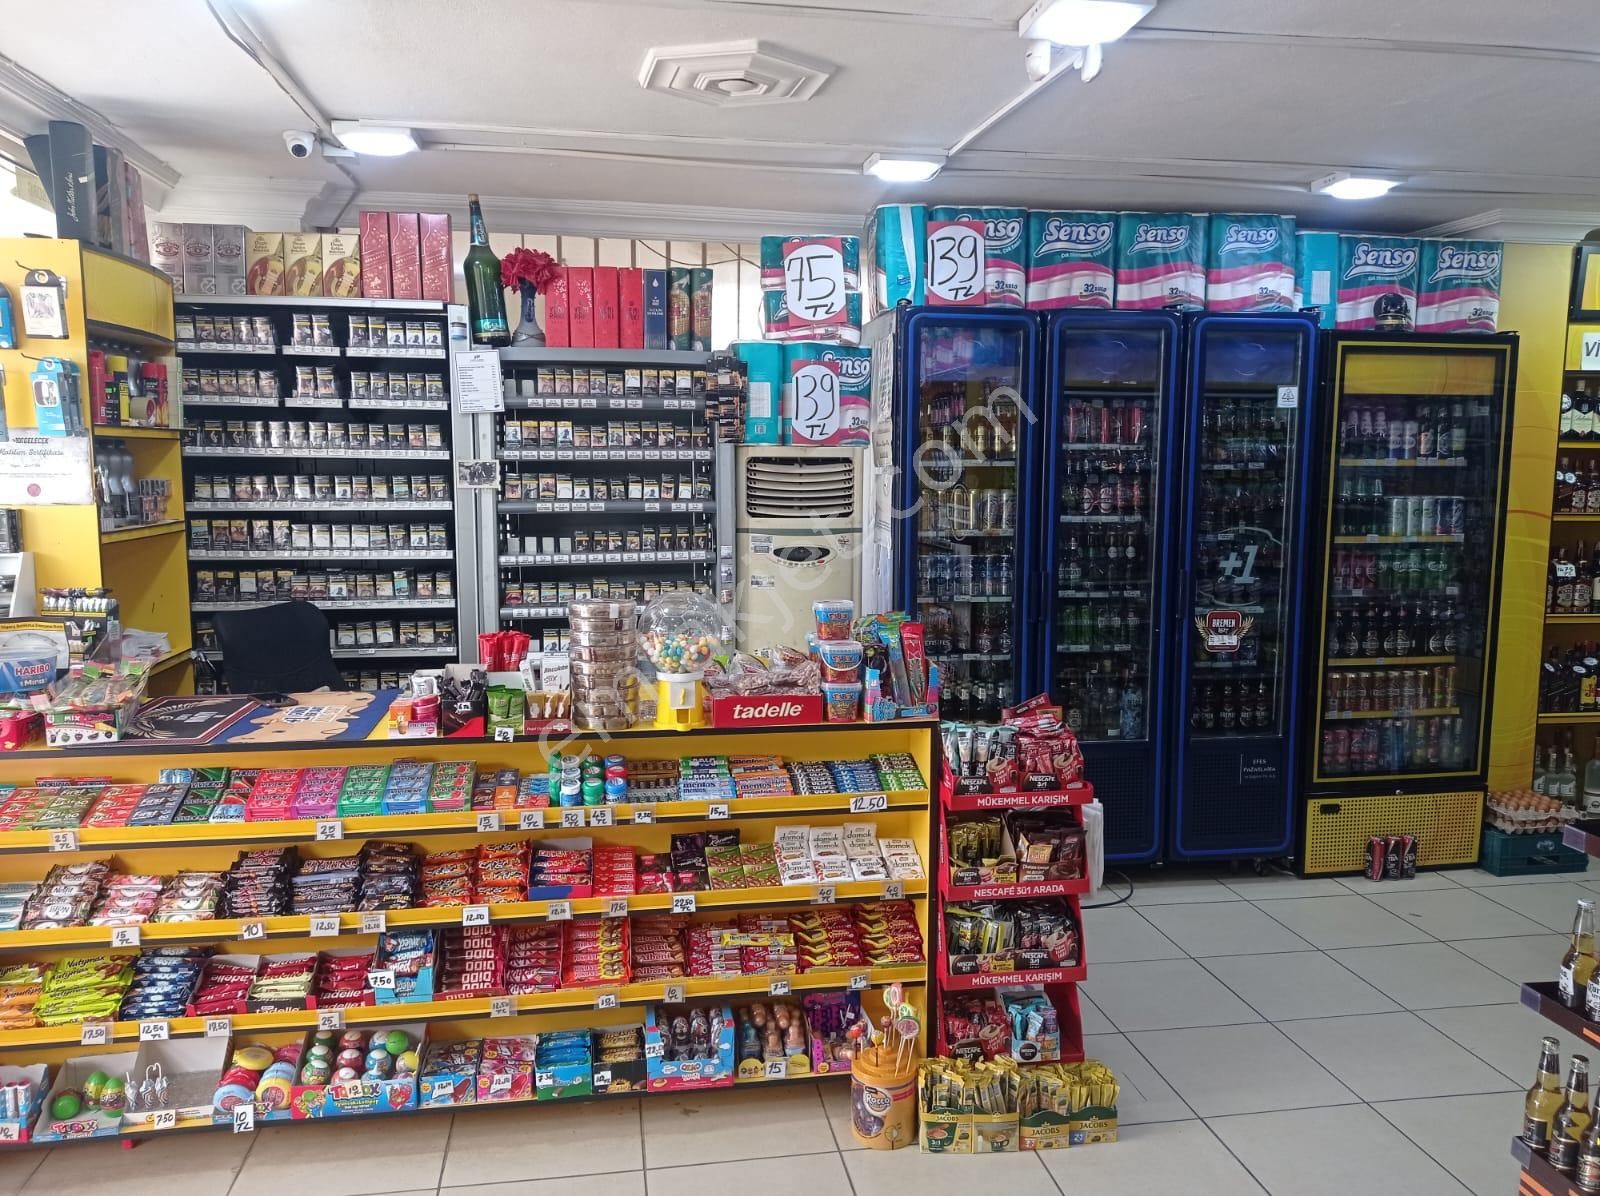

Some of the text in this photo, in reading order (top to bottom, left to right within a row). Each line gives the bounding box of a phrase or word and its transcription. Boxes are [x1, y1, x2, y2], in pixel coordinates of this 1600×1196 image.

[1046, 217, 1113, 243] Senso
[1134, 223, 1190, 243] Senso
[1226, 224, 1278, 243] Senso
[1353, 242, 1418, 266] Senso
[1438, 245, 1499, 269] Senso
[928, 234, 979, 288] 139
[786, 254, 837, 302] 75
[994, 280, 1005, 290] 32
[1083, 283, 1095, 294] 32
[948, 286, 976, 300] TL
[1168, 286, 1179, 296] 32
[1258, 286, 1270, 296] 32
[804, 302, 837, 317] TL
[1471, 307, 1483, 318] 32
[822, 351, 871, 377] Snso
[793, 373, 837, 422] 139
[851, 416, 860, 427] 32
[806, 424, 830, 438] TL
[1211, 618, 1236, 628] BREMEN
[15, 663, 51, 676] HARIBO
[732, 702, 803, 720] tadelle
[853, 796, 886, 811] 12.50
[977, 794, 1069, 807] MÜKEMMEL KARIŞIM
[592, 809, 606, 818] 45
[710, 806, 719, 816] 15
[479, 815, 491, 826] 15
[523, 813, 535, 823] 10
[564, 813, 579, 823] 50
[320, 825, 336, 835] 25
[54, 833, 68, 842] 25
[819, 888, 832, 896] 40
[886, 885, 899, 893] 40
[1033, 883, 1065, 893] ARADA
[116, 930, 127, 939] 15
[244, 924, 259, 937] 10
[971, 971, 1063, 986] MÜKEMMEL KARIŞIM
[321, 1016, 333, 1026] 25
[768, 1062, 783, 1075] 15
[864, 1094, 890, 1107] Rocco
[235, 1111, 247, 1123] 10
[236, 1121, 253, 1132] TL
[1031, 1126, 1061, 1136] JACOBS
[1079, 1121, 1108, 1130] JACOBS
